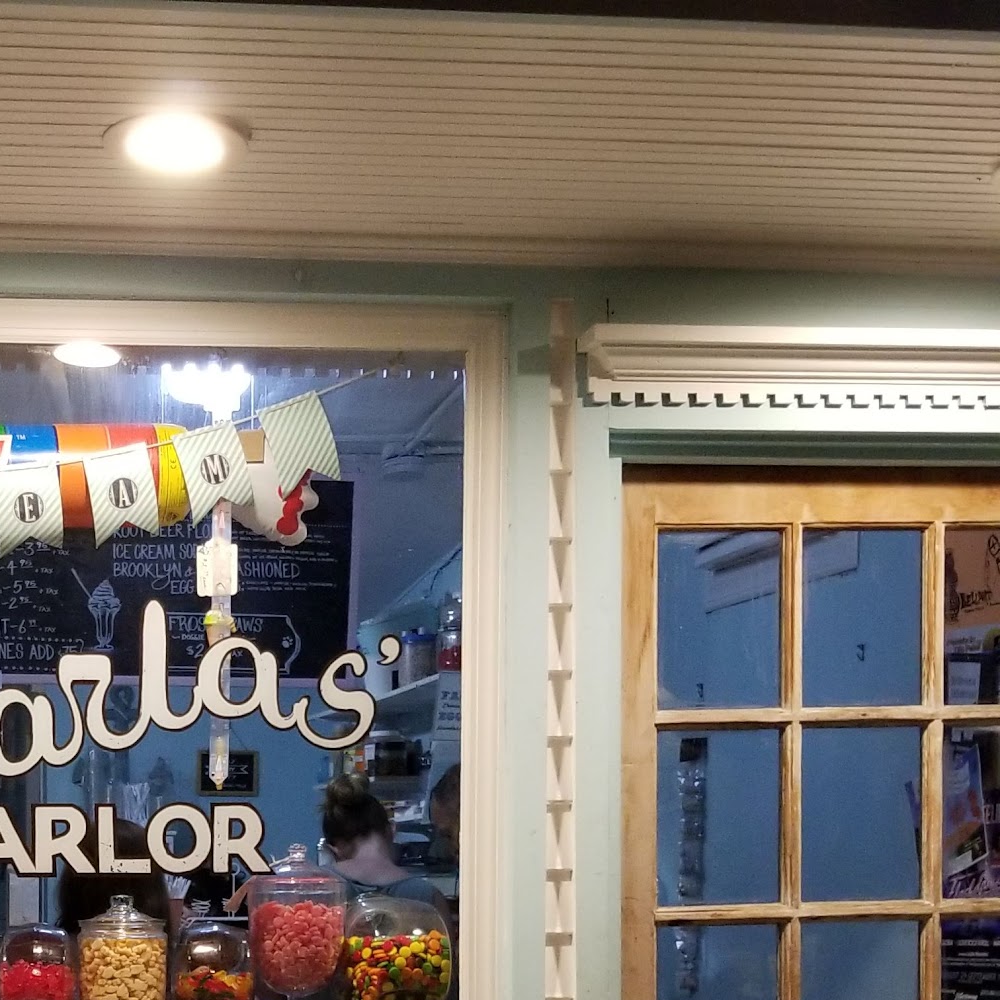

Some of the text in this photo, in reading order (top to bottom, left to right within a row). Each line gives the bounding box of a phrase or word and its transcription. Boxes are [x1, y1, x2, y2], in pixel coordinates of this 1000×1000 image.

[112, 543, 132, 559] ICE
[134, 544, 175, 560] CREAM
[170, 580, 195, 595] EGG
[29, 644, 54, 661] ADD
